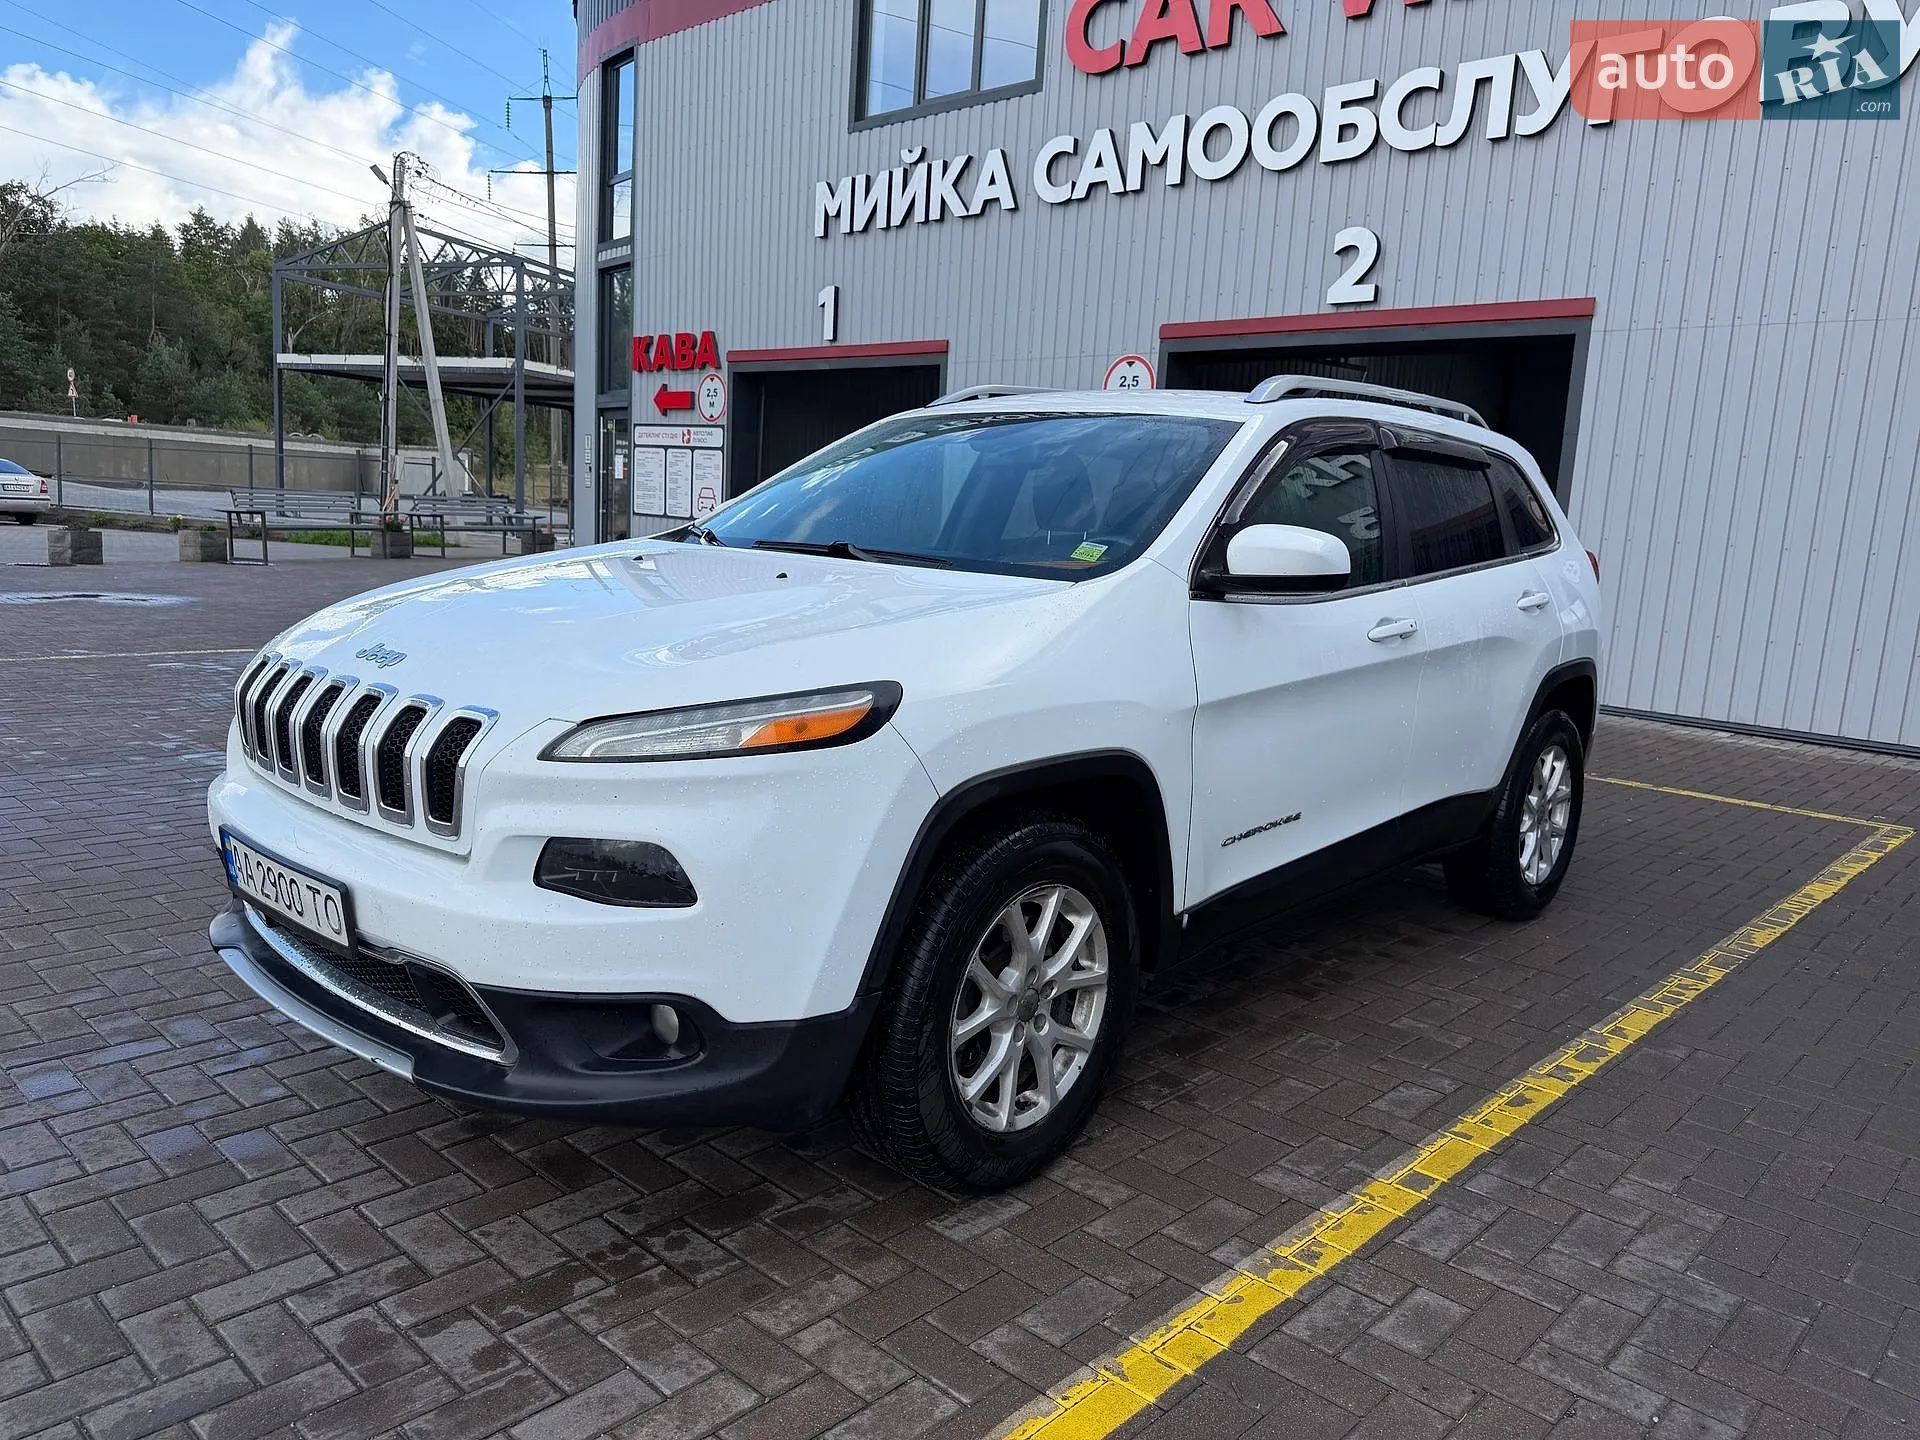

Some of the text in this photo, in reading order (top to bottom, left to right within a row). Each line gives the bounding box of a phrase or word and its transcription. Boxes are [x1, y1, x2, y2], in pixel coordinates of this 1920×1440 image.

[815, 146, 1018, 238] МИЙКА
[1326, 226, 1380, 305] 2
[817, 285, 839, 342] 1
[632, 331, 720, 373] КАВА
[706, 388, 718, 399] 2,5
[1119, 375, 1139, 390] 2,5
[356, 643, 407, 669] Jeep
[1221, 812, 1302, 847] CHEROKEE
[233, 845, 341, 935] AA 2900 TO
